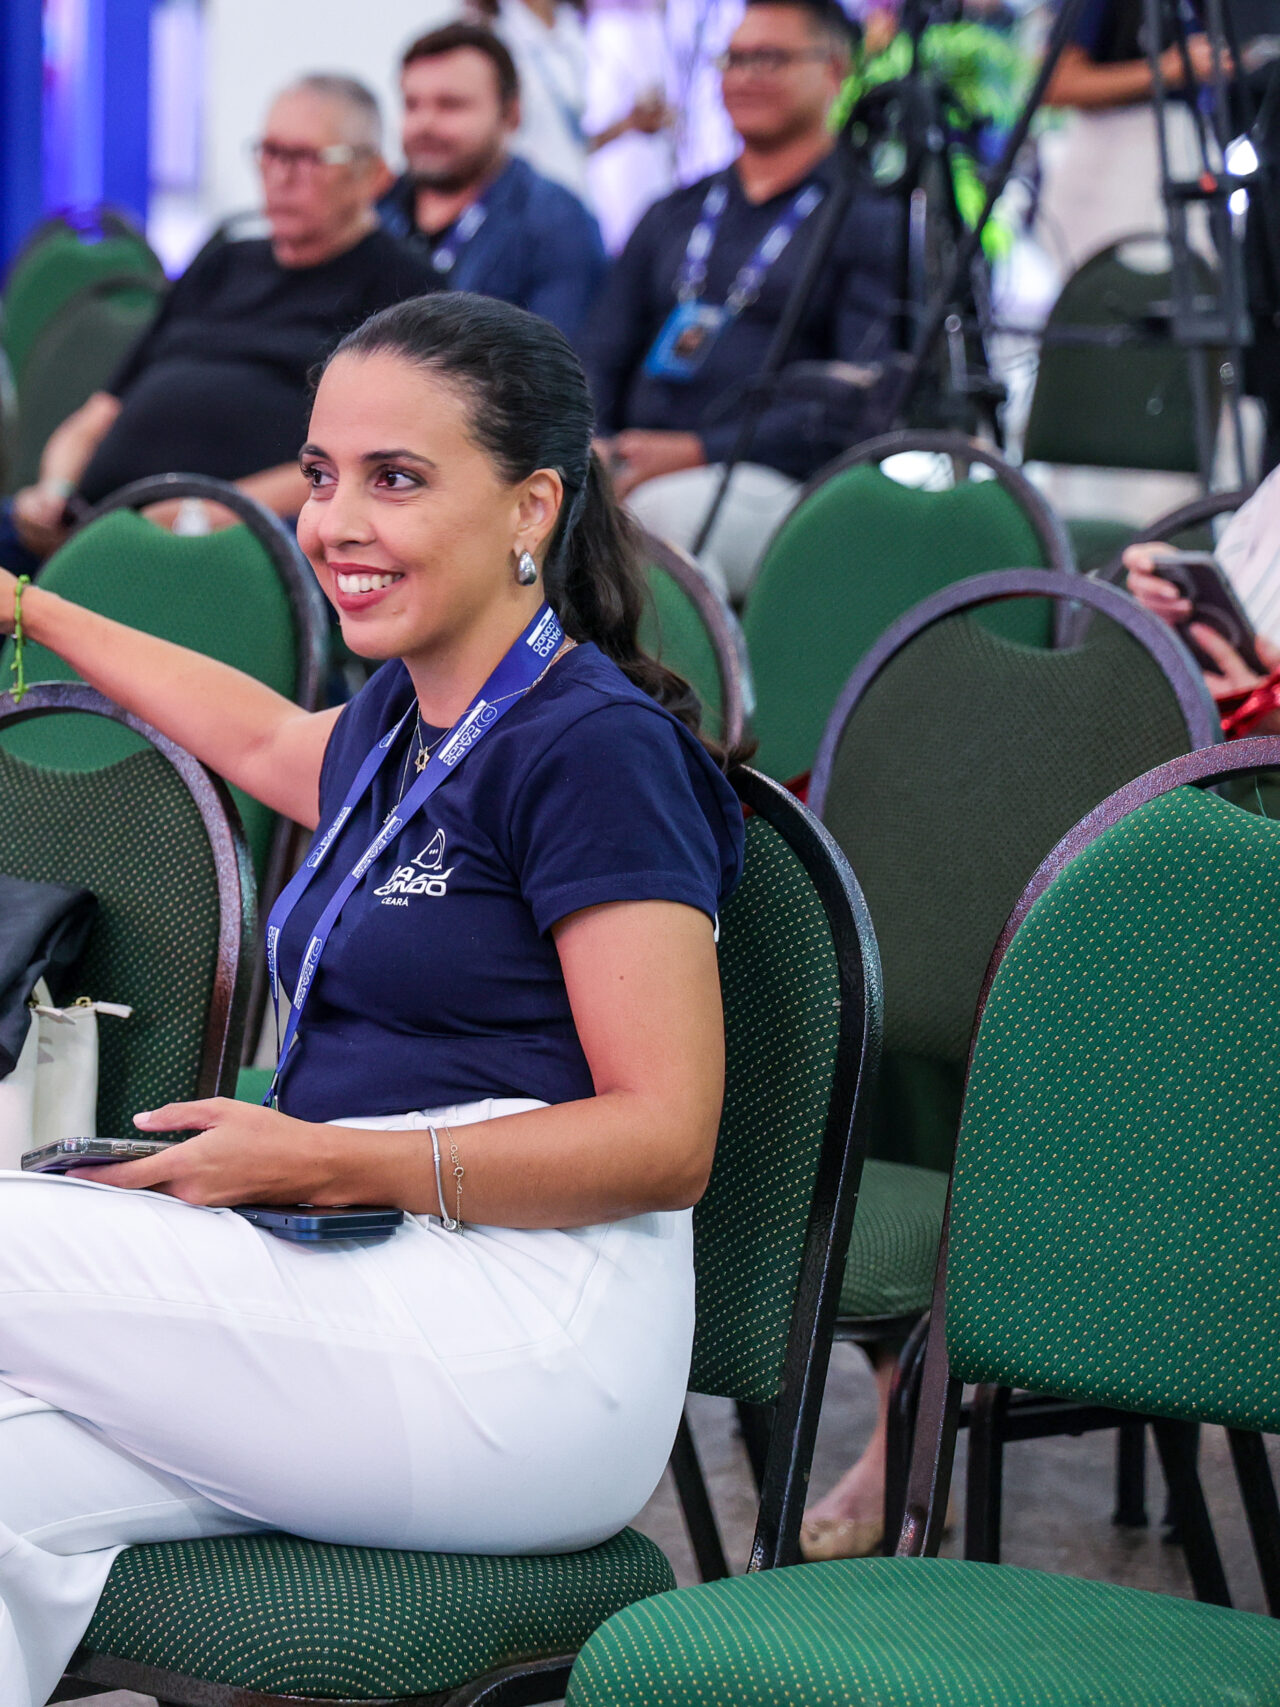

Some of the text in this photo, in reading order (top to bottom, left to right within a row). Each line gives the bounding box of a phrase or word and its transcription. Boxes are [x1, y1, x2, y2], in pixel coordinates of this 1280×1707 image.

[532, 621, 556, 653] CONDO
[538, 626, 562, 658] PAPO
[442, 724, 476, 764] CONDO
[446, 727, 482, 767] PAPO
[381, 896, 409, 907] CEARÁ
